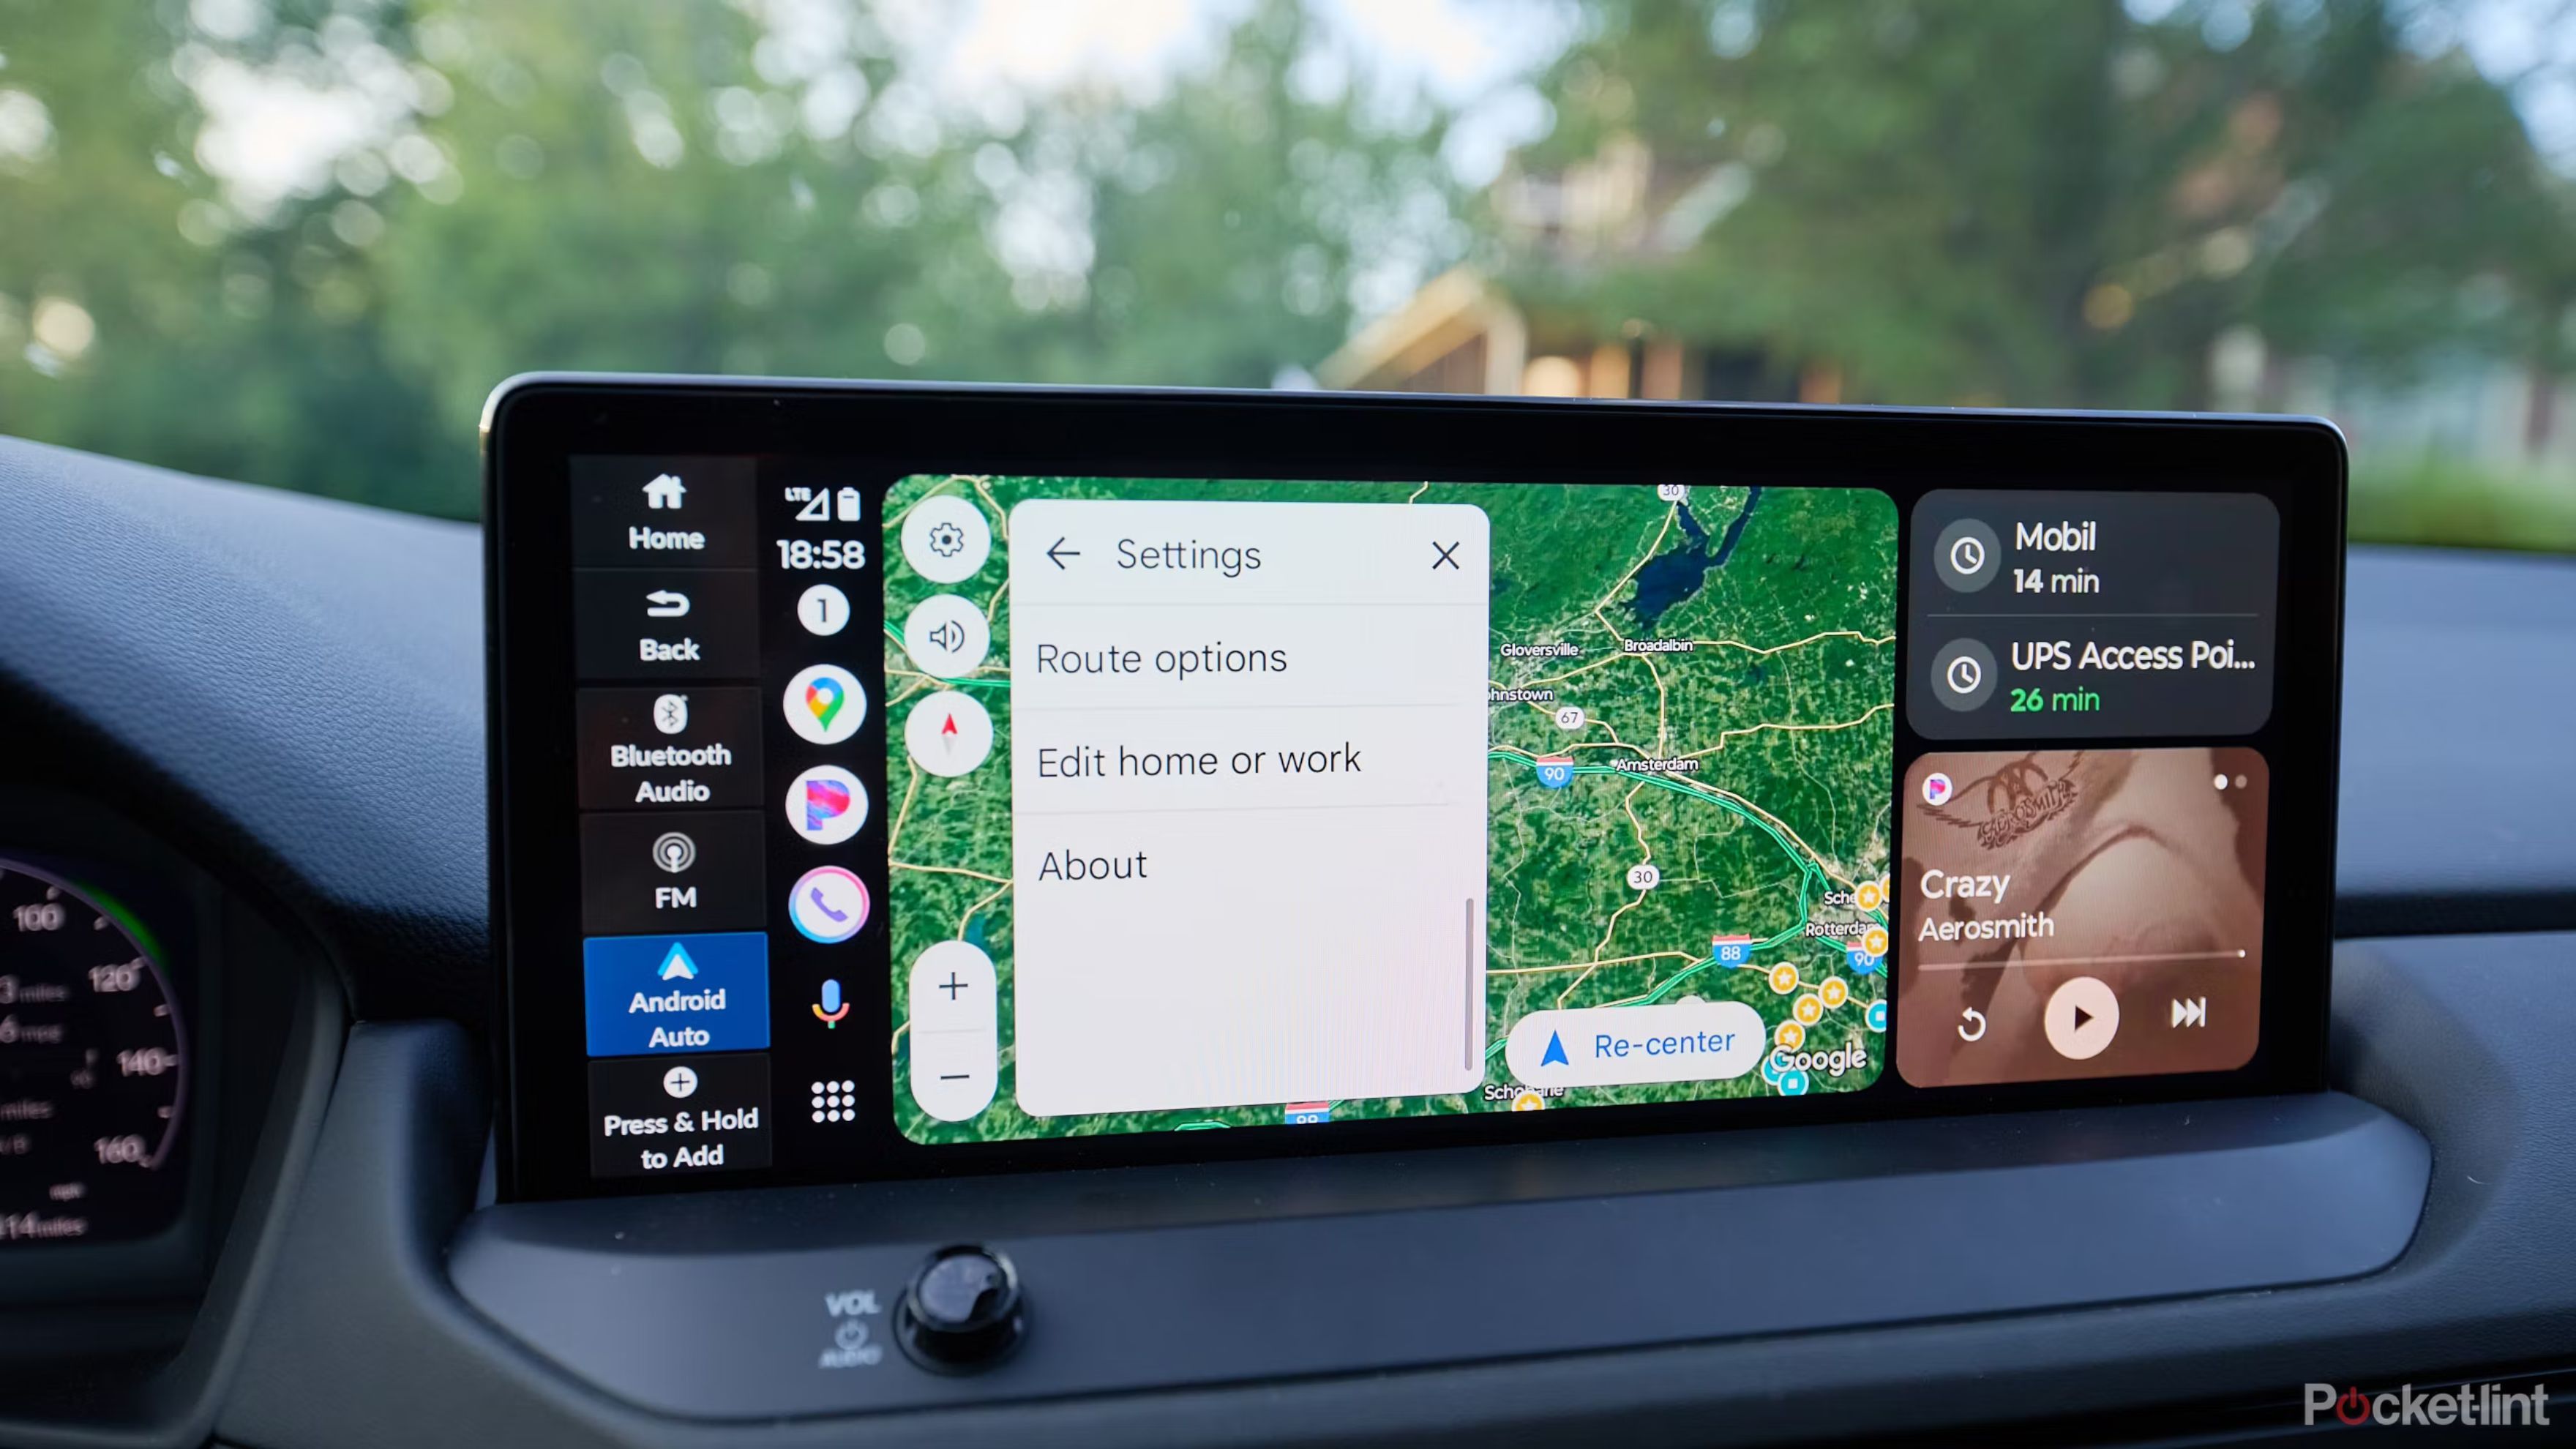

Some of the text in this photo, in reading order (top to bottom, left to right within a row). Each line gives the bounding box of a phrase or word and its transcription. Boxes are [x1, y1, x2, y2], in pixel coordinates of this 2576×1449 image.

[785, 487, 812, 501] LTE
[629, 526, 705, 550] Home
[2015, 521, 2096, 551] Mobil
[776, 540, 866, 569] 18:58
[1117, 538, 1262, 577] Settings
[2013, 568, 2100, 594] 14 min
[817, 599, 828, 622] 1
[640, 637, 700, 661] Back
[1500, 643, 1579, 657] Gloversville
[1624, 637, 1694, 653] Broadalbin
[2011, 639, 2255, 670] UPS Access Poi...
[1037, 641, 1288, 681] Route options
[2010, 686, 2100, 712] 26 min
[1561, 712, 1579, 724] 67
[610, 744, 731, 768] Bluetooth
[1038, 741, 1362, 779] Edit home or work
[1616, 757, 1699, 771] Amsterdam
[1544, 767, 1565, 781] 90
[634, 779, 711, 803] Audio
[1039, 849, 1148, 882] About
[1633, 870, 1653, 884] 30
[655, 886, 697, 909] FM
[1920, 869, 2011, 904] Crazy
[13, 903, 67, 932] 100
[1917, 910, 2055, 942] Aerosmith
[1720, 946, 1741, 961] 88
[1854, 952, 1875, 967] 90
[89, 965, 141, 992] 120
[628, 989, 726, 1014] Android
[648, 1027, 710, 1048] Auto
[1595, 1030, 1736, 1058] Re-center
[116, 1046, 169, 1077] 140
[1768, 1041, 1868, 1077] Google
[604, 1107, 760, 1137] Press & Hold
[640, 1144, 724, 1169] to Add
[825, 1289, 880, 1317] VOL
